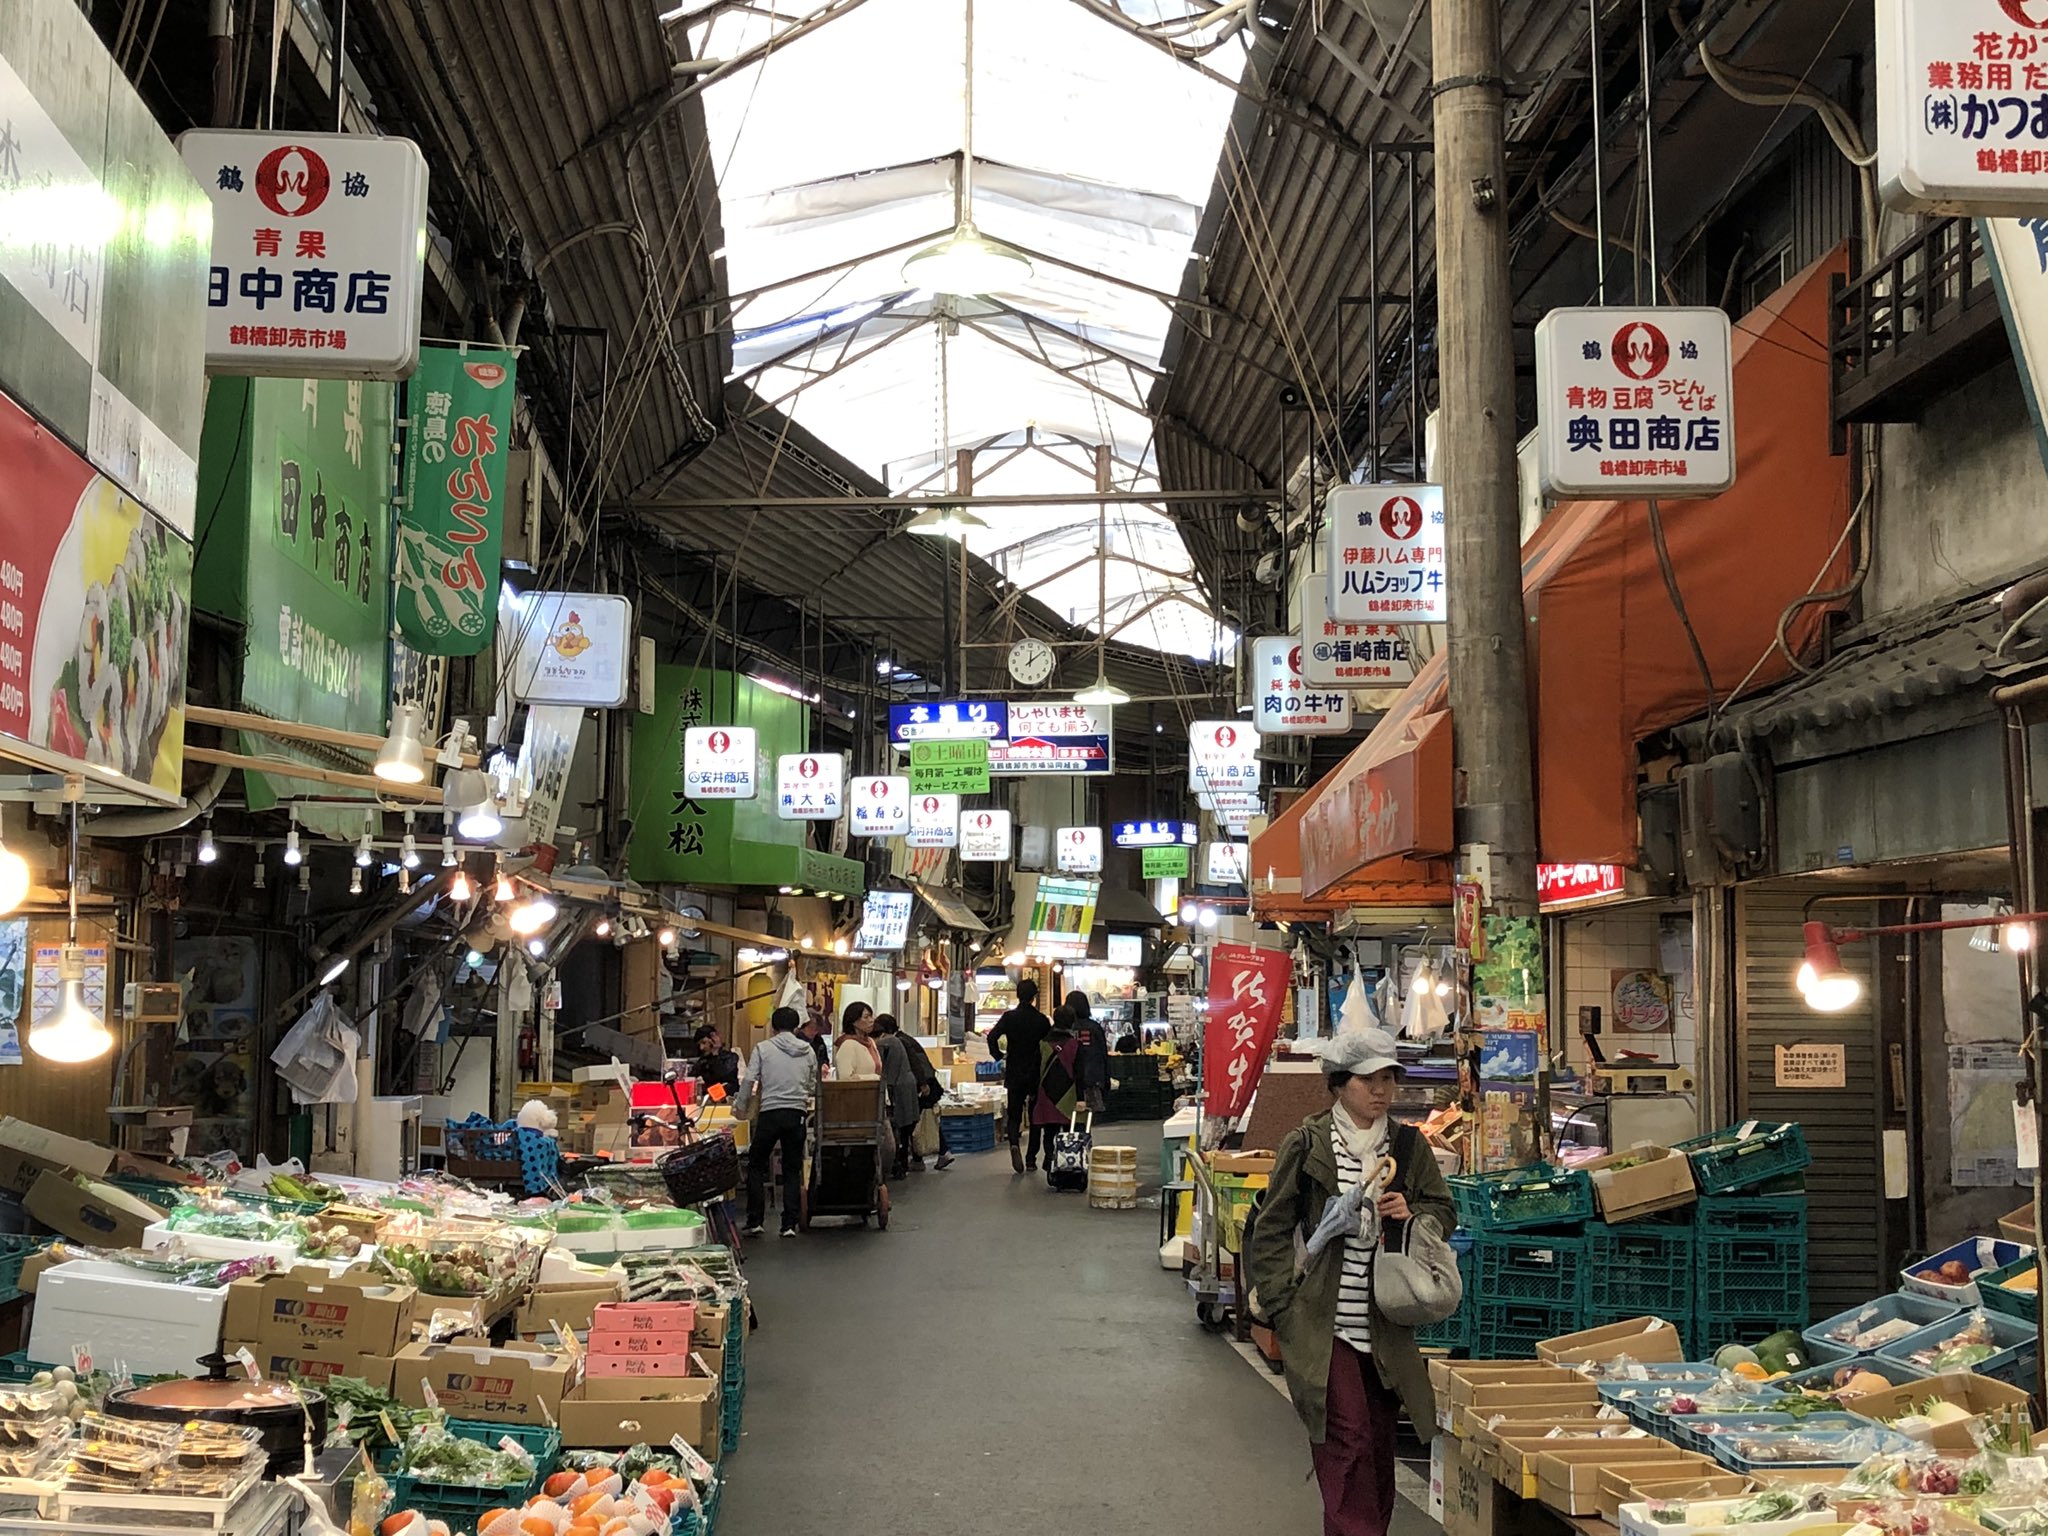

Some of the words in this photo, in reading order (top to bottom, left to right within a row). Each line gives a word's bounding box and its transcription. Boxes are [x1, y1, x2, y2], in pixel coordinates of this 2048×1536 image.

[1972, 31, 2048, 60] 花か
[1928, 61, 2012, 91] 業務用
[216, 165, 243, 192] 鶴
[341, 171, 369, 198] 協
[253, 228, 325, 259] 青果
[209, 266, 391, 314] 田中商店
[229, 325, 347, 350] 鶴橋卸売市場
[1582, 341, 1602, 360] 鶴
[1679, 341, 1698, 359] 協
[1566, 385, 1607, 409] 青物
[1612, 386, 1654, 409] 豆腐
[1658, 379, 1704, 395] うどん
[1678, 394, 1717, 411] そば
[1566, 414, 1720, 452] 奥田商店
[1600, 459, 1688, 476] 鶴橋卸売市場
[280, 457, 371, 606] 田中商店
[0, 559, 24, 598] 480円
[0, 600, 24, 638] 480円
[1368, 600, 1434, 612] 鶴橋卸売市場
[0, 641, 23, 679] 480円
[1331, 639, 1410, 661] 福崎商店
[1335, 667, 1391, 677] 鶴橋卸売市場
[0, 681, 24, 718] 480円
[1264, 694, 1344, 713] 肉の牛竹
[700, 771, 749, 784] 安井商店
[1227, 970, 1267, 1109] 佐賀牛
